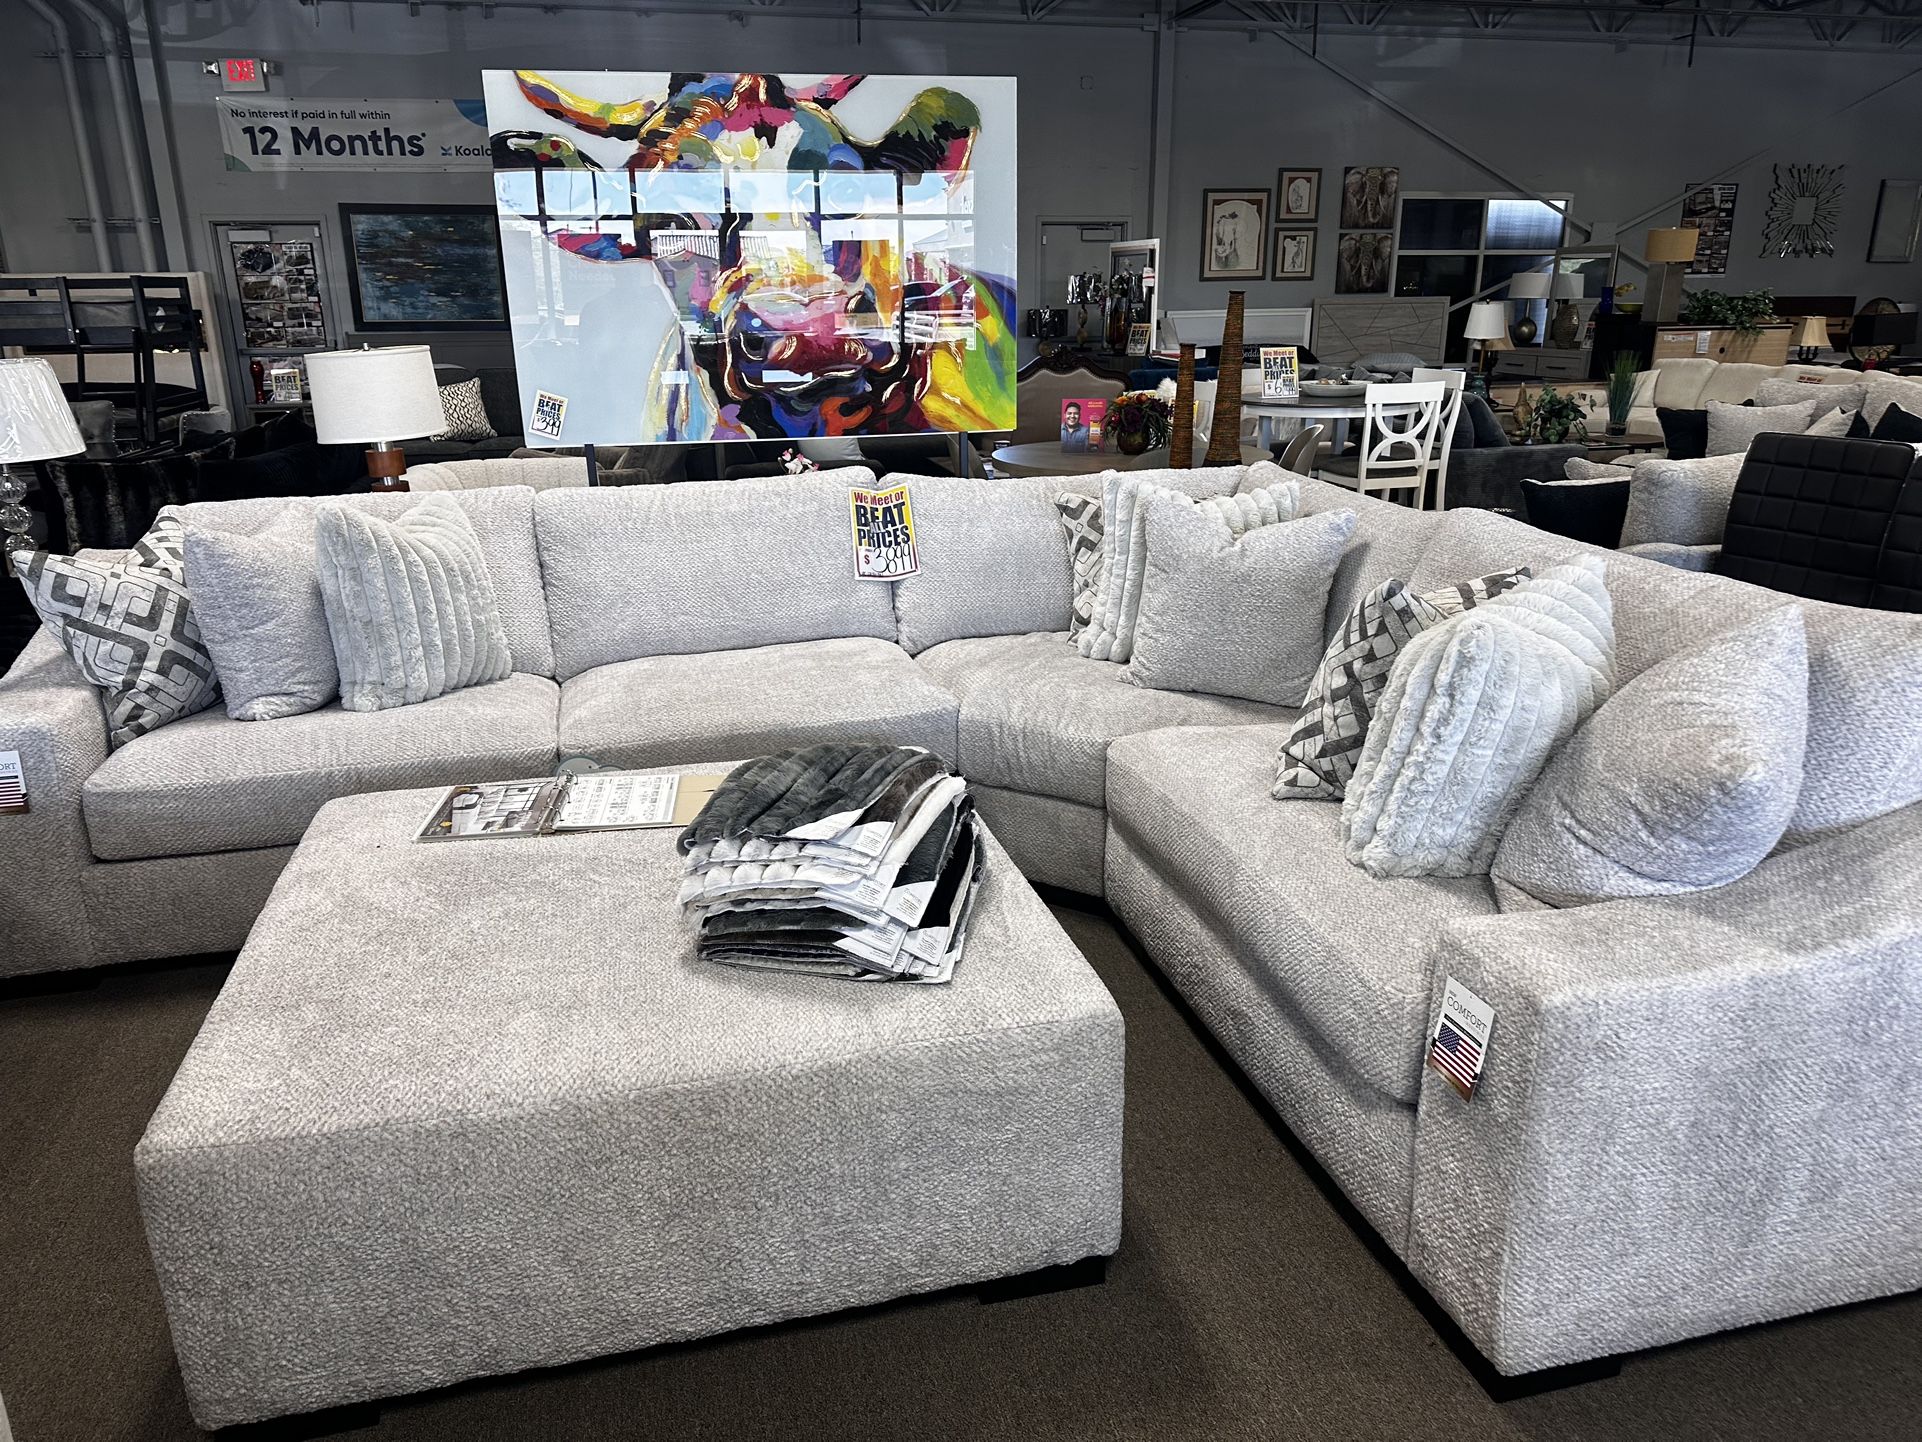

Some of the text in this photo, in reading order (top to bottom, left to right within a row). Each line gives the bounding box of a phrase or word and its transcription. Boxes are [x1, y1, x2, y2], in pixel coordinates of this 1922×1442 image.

[231, 108, 391, 121] No interest if paid in full within
[241, 126, 281, 156] 12
[1263, 357, 1294, 369] BEAT
[274, 376, 297, 384] BEAT
[538, 399, 562, 412] BEAT
[536, 408, 561, 421] PRICES
[854, 490, 905, 505] We Meet or
[855, 501, 906, 529] BEAT
[857, 525, 911, 549] PRICES
[1446, 996, 1488, 1035] COMFORT
